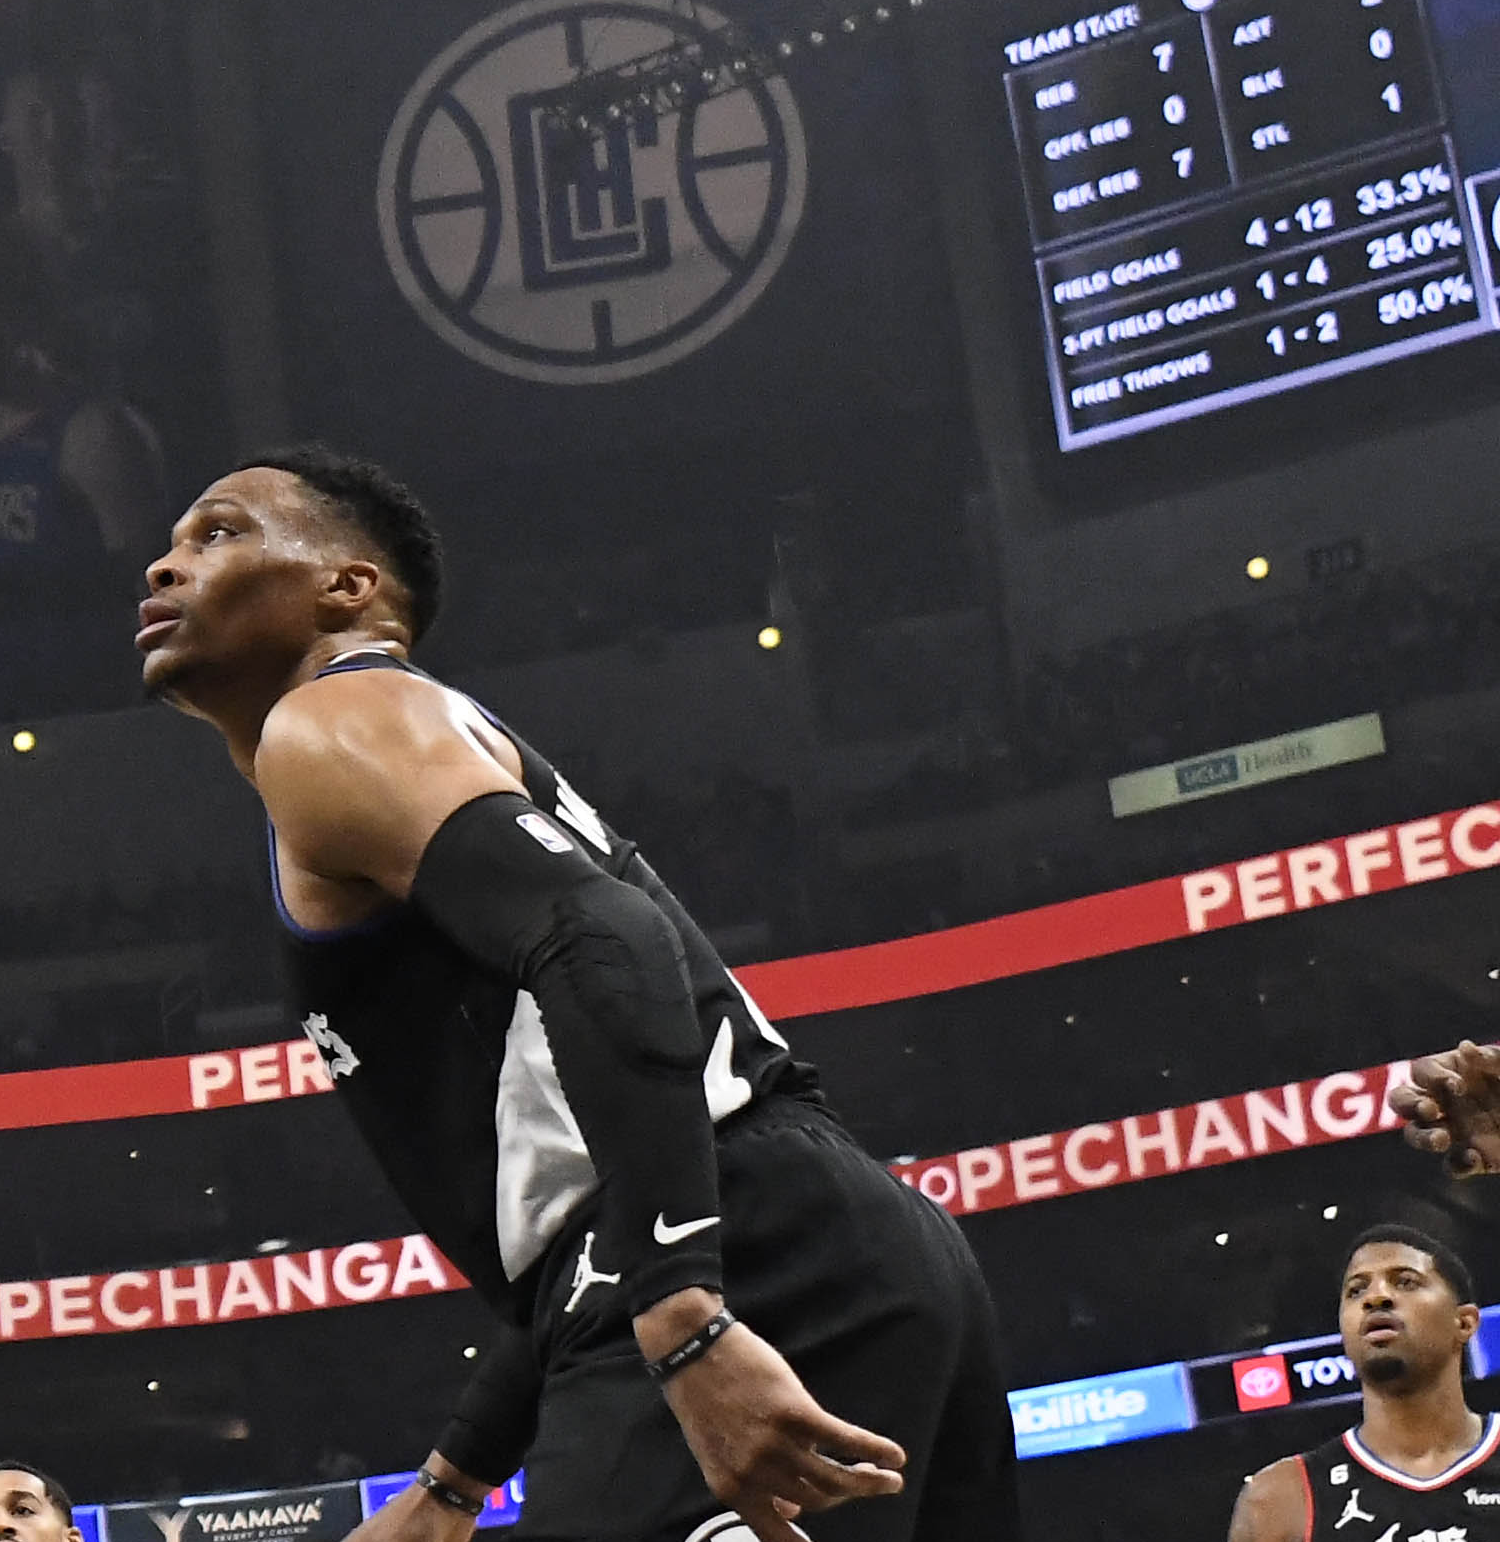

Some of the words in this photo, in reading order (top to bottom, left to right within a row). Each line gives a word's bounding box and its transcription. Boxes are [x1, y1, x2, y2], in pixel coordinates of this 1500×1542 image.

[1369, 28, 1394, 60] 0
[1163, 94, 1187, 126] 0
[1381, 82, 1402, 114] 1
[1244, 217, 1269, 247] 4
[1295, 198, 1336, 234] 12
[1356, 165, 1453, 218] 33.3%
[1256, 271, 1275, 301] 1
[1305, 256, 1330, 287] 4
[1366, 217, 1463, 270] 25.0%
[1267, 326, 1286, 357] 1
[1315, 312, 1339, 343] 2
[1378, 273, 1474, 325] 50.0%
[1181, 804, 1500, 932] PERFEC
[1294, 1359, 1358, 1389] TOY
[1330, 1463, 1349, 1486] 6
[1463, 1487, 1500, 1506] hon
